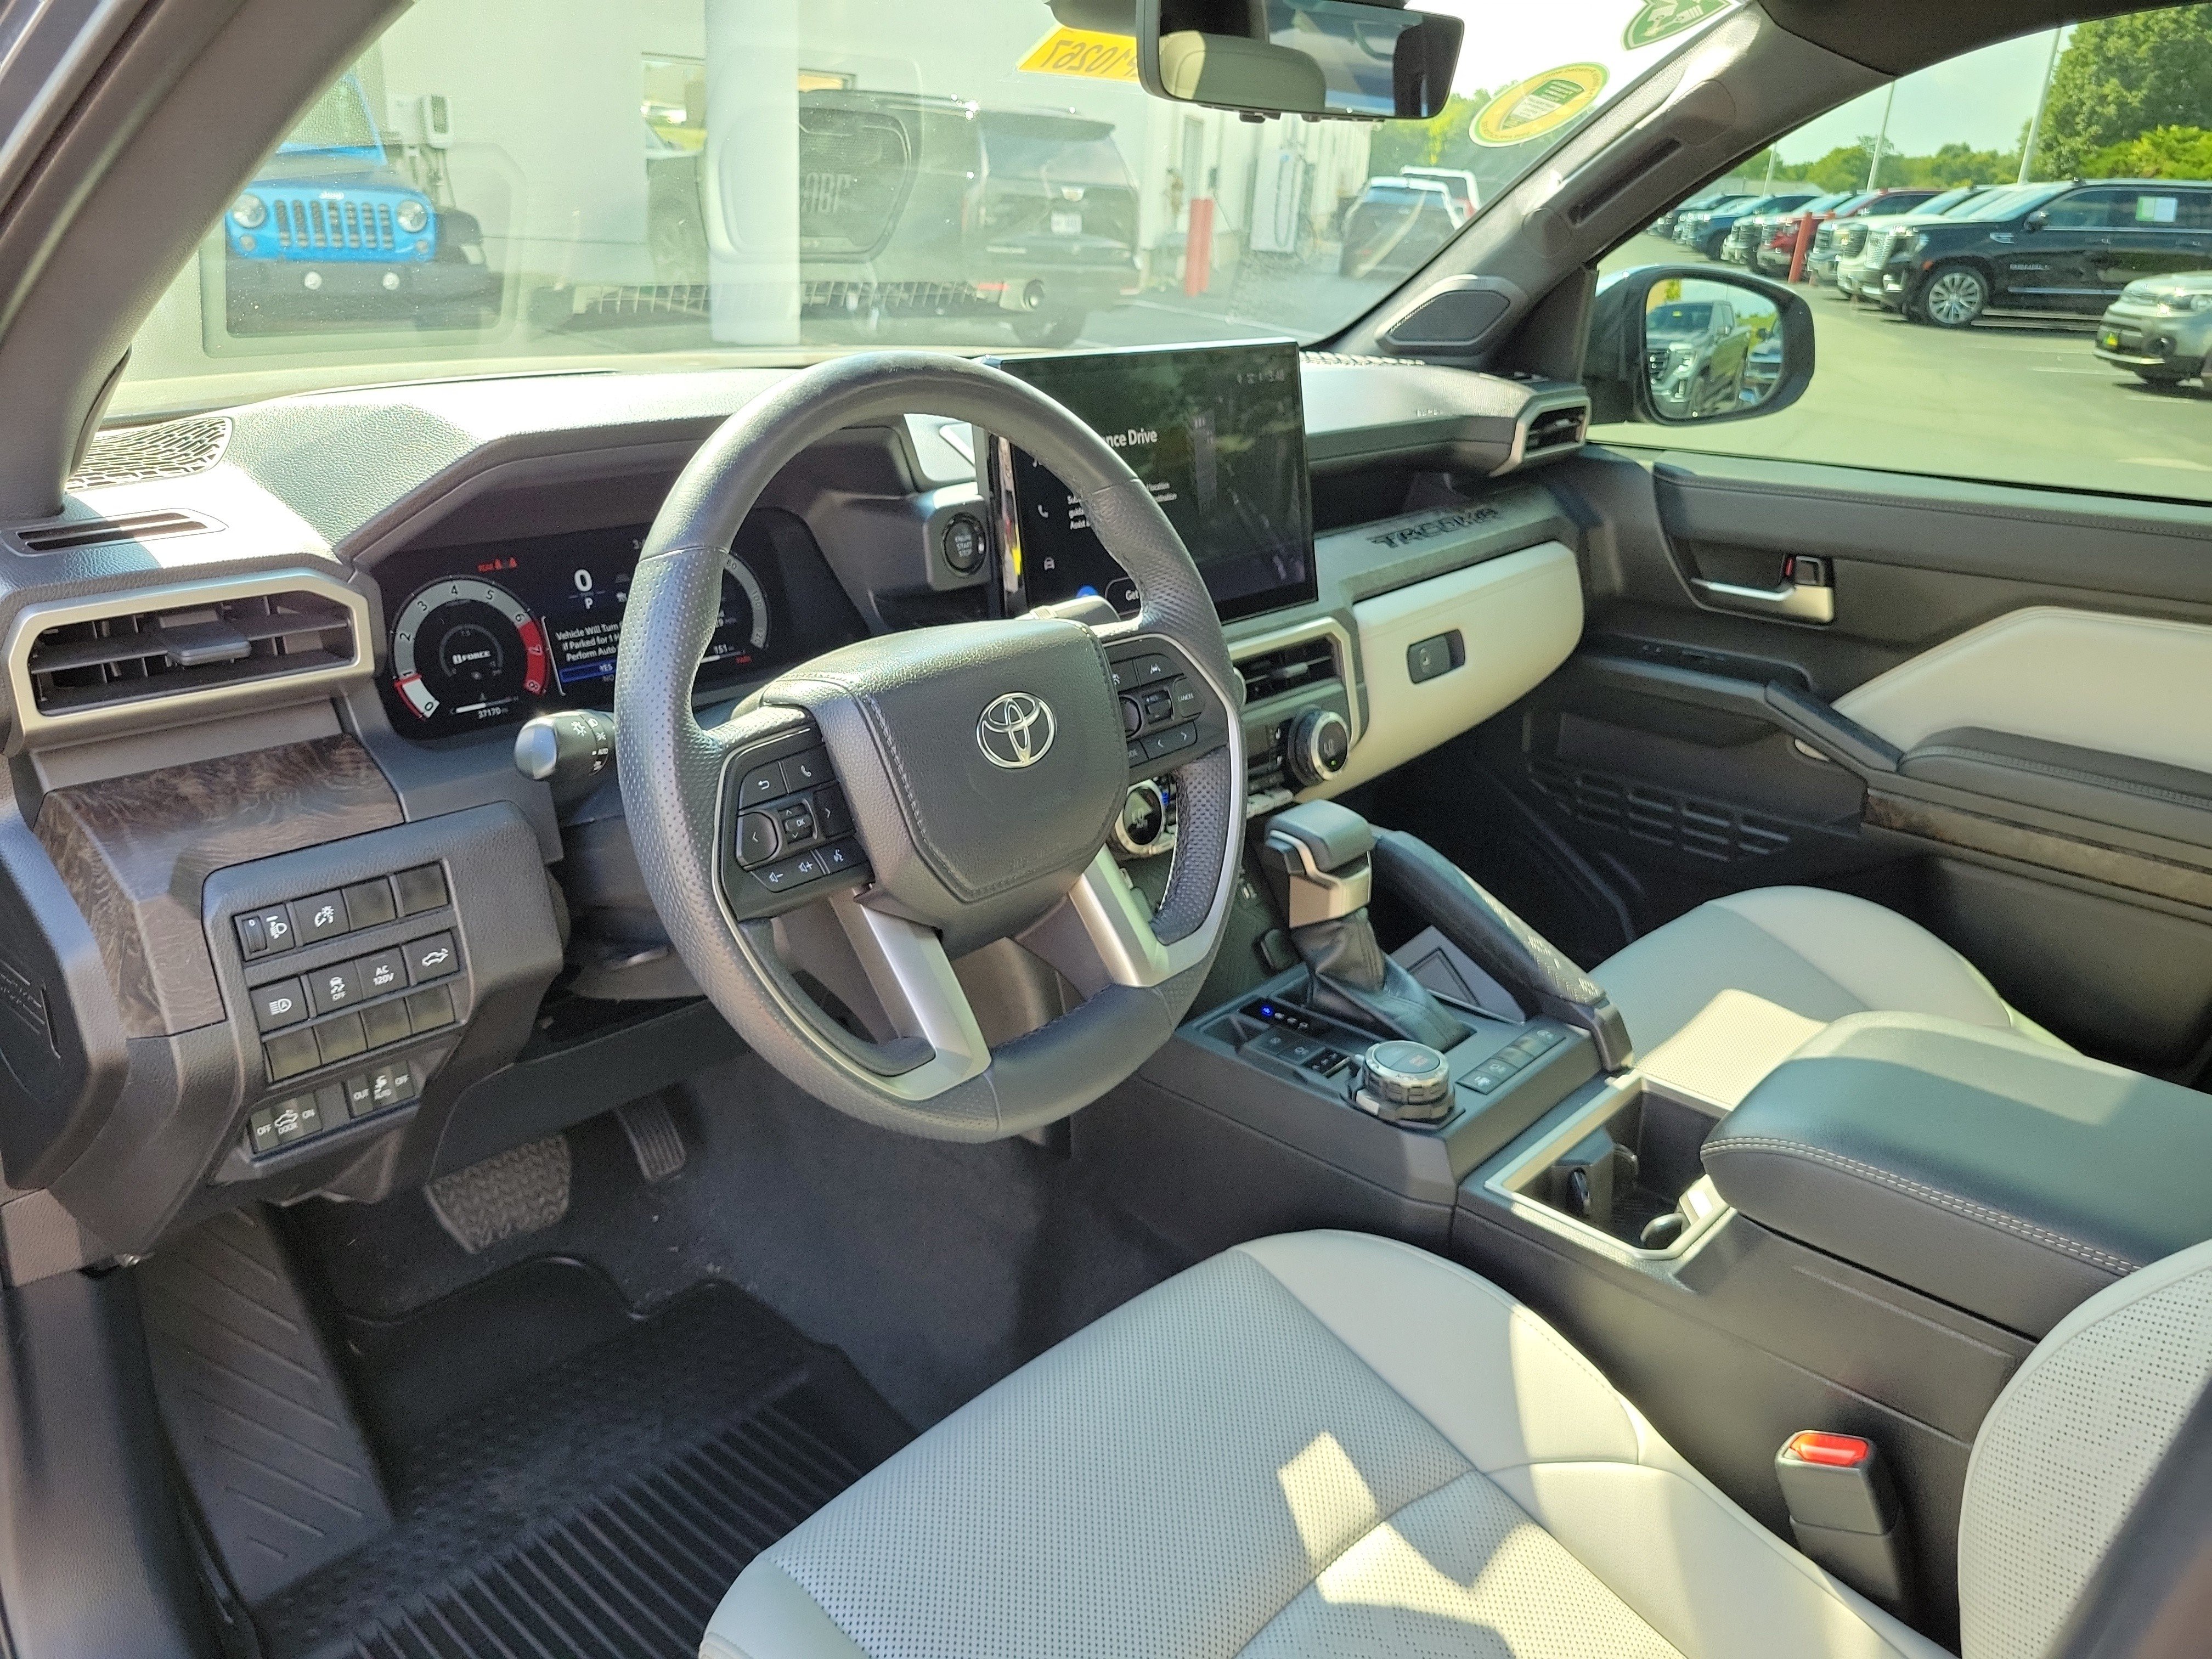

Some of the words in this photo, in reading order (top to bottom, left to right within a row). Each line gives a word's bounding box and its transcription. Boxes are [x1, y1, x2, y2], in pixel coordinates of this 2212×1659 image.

[1128, 428, 1158, 445] Drive
[574, 568, 592, 592] 0
[451, 585, 459, 596] 4
[486, 589, 495, 600] 5
[1125, 590, 1139, 601] Get
[417, 600, 428, 612] 3
[584, 597, 593, 610] P
[515, 613, 526, 622] 6
[399, 632, 411, 642] 2
[555, 628, 585, 640] Vehicle
[584, 624, 602, 635] Will
[601, 623, 619, 633] Turn
[568, 637, 596, 650] Parked
[596, 635, 608, 645] for
[528, 644, 542, 656] 7
[566, 650, 597, 662] Perform
[597, 646, 617, 657] Auto
[527, 680, 541, 692] 8
[424, 701, 434, 712] 0
[478, 707, 501, 719] 37170
[796, 818, 805, 827] OK
[376, 965, 390, 977] AC
[373, 972, 394, 986] 120V
[332, 991, 346, 1001] OFF
[395, 1074, 410, 1086] OFF
[302, 1109, 315, 1119] ON
[256, 1124, 272, 1136] OFF
[278, 1122, 298, 1136] DOOR
